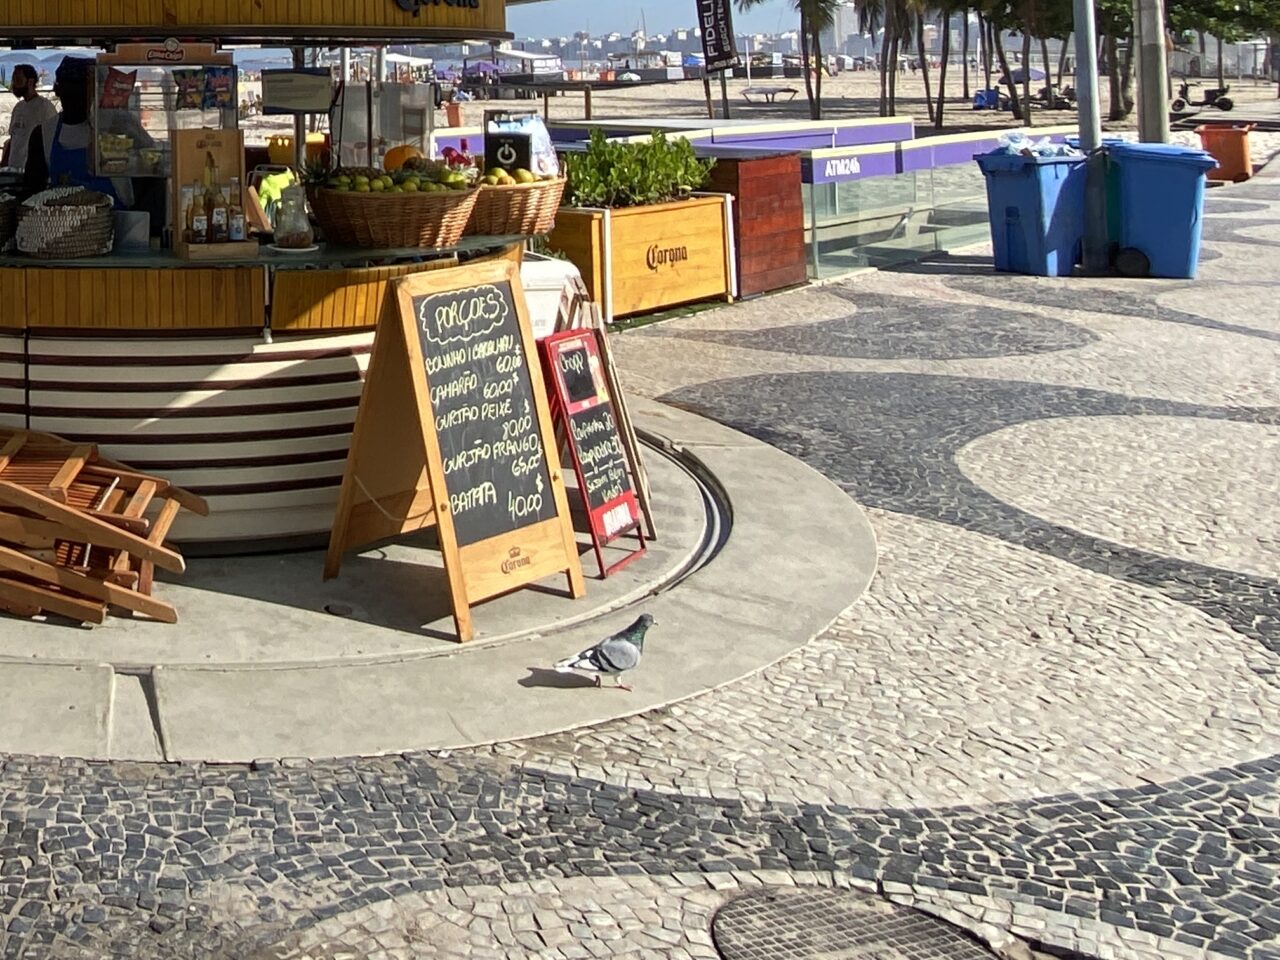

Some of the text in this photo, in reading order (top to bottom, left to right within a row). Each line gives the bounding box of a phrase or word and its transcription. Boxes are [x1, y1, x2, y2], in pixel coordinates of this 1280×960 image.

[718, 20, 731, 52] BEACH
[824, 157, 861, 177] ATM24h
[646, 244, 688, 273] Corona
[425, 348, 466, 375] BOLINHO
[483, 379, 513, 399] 60,00
[481, 398, 513, 420] PEIXE
[492, 433, 538, 460] FRANGO
[450, 481, 543, 521] BATATA 40,00
[500, 555, 531, 575] Corona
